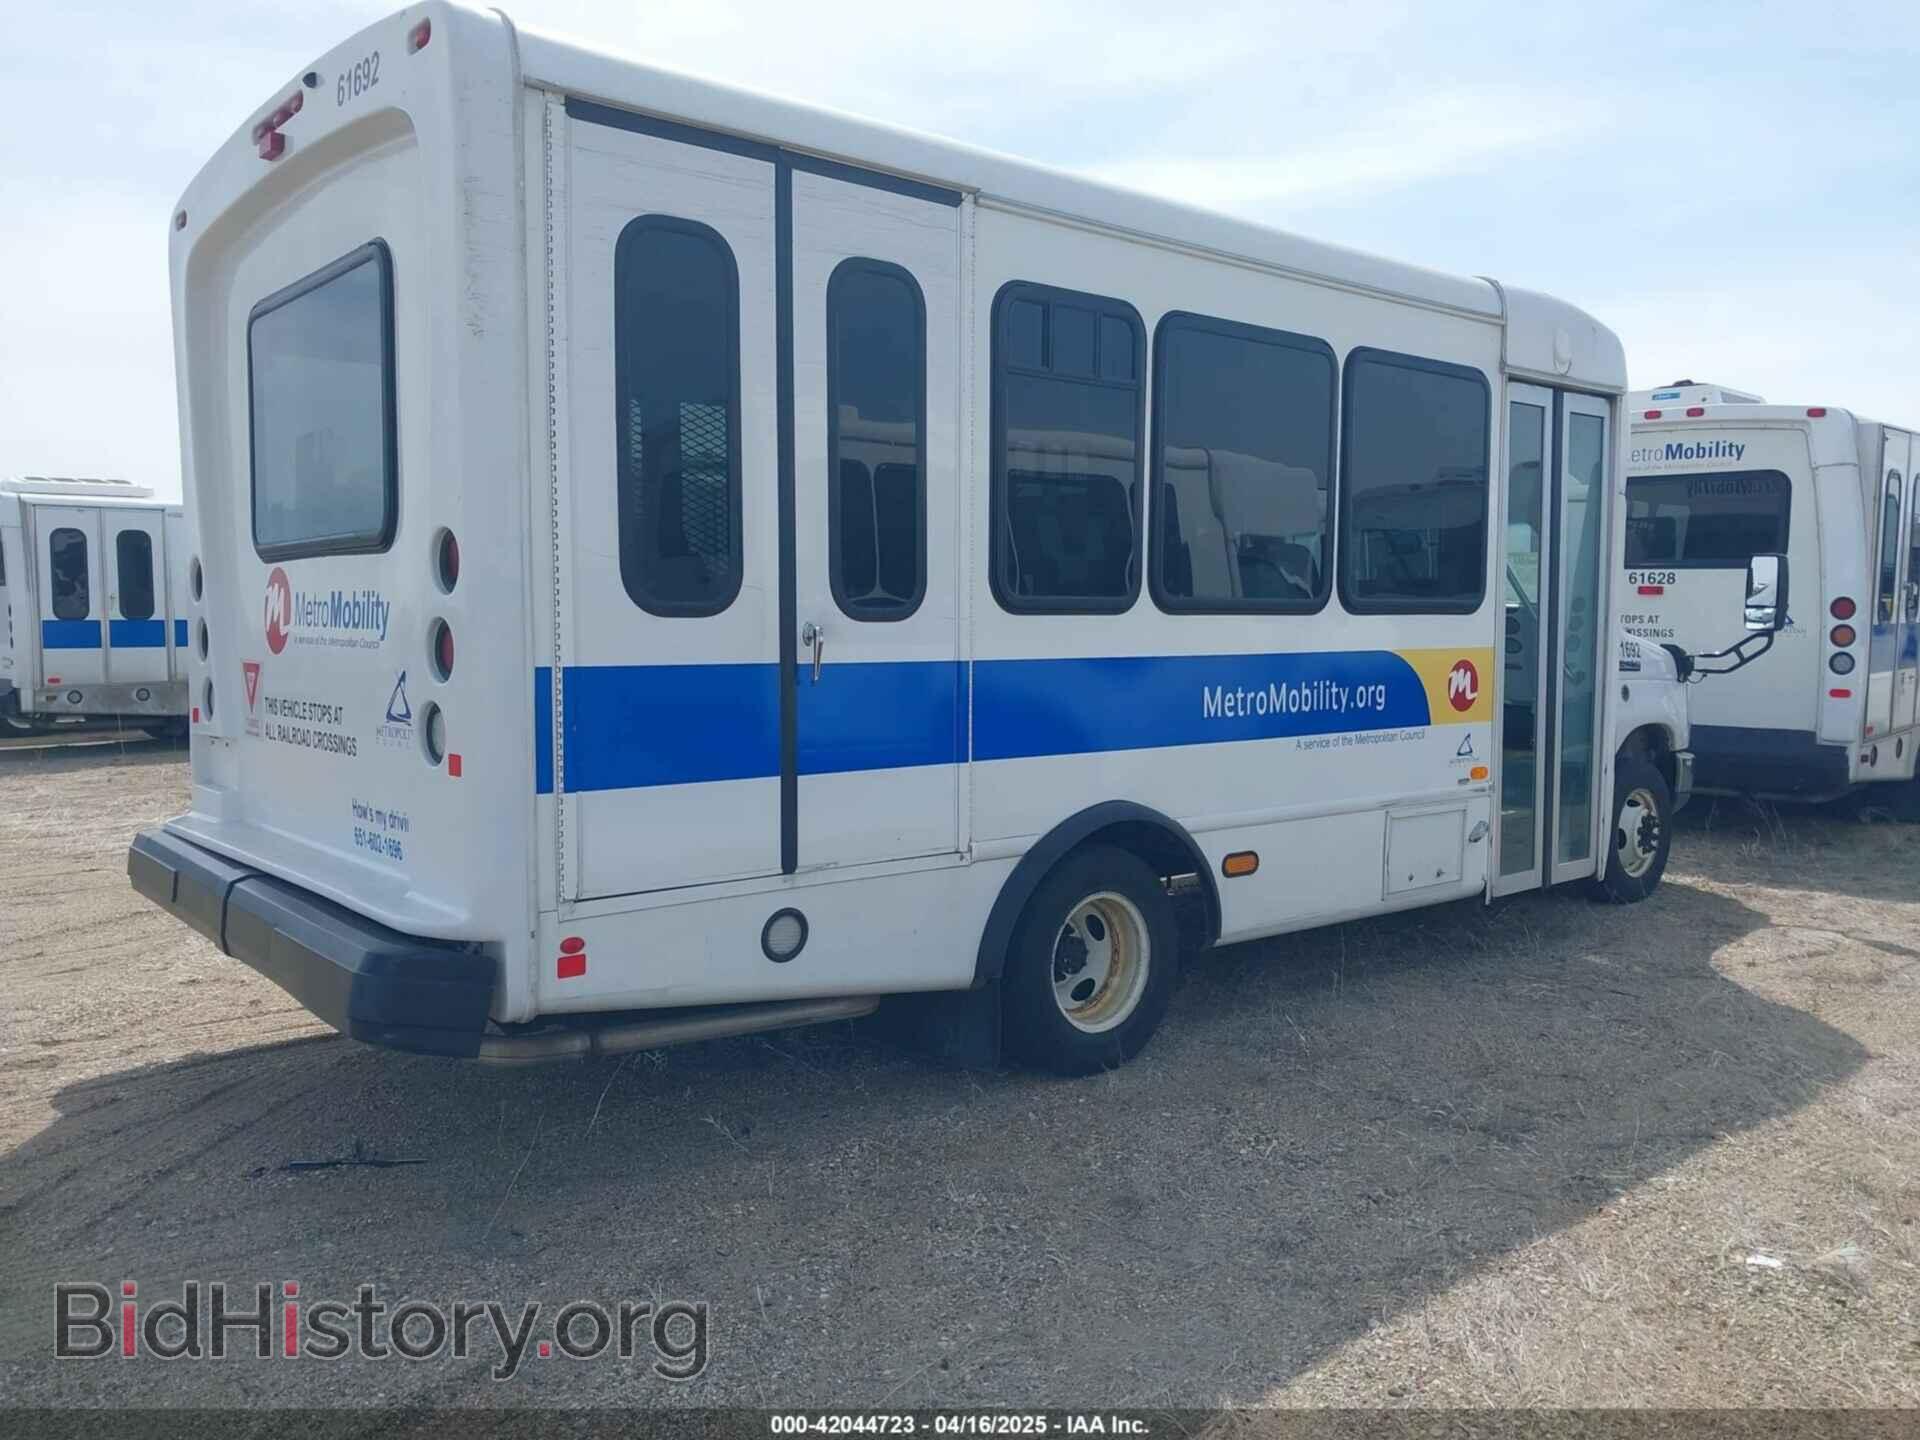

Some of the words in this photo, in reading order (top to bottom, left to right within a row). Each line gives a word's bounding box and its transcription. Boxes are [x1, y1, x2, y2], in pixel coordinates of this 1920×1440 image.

[337, 50, 380, 107] 61692
[1631, 440, 1746, 461] etroMobility
[1628, 571, 1676, 585] 61628
[295, 590, 391, 641] MetroMobility
[1620, 614, 1645, 624] TOPS
[1647, 614, 1660, 624] AT
[1630, 628, 1675, 638] OSSINGS
[264, 696, 278, 716] THIS
[279, 699, 307, 720] VEHICLE
[308, 702, 332, 724] STOPS
[334, 706, 343, 725] AT
[1203, 679, 1387, 719] MetroMobility.org
[265, 720, 277, 741] ALL
[277, 724, 311, 748] RAILROAD
[313, 730, 357, 757] CROSSINGS
[1303, 738, 1331, 751] service
[1332, 736, 1339, 748] of
[1341, 735, 1353, 747] the
[1355, 731, 1398, 746] Metropolitan
[1400, 730, 1425, 742] Council
[352, 798, 374, 823] How's
[375, 809, 387, 831] my
